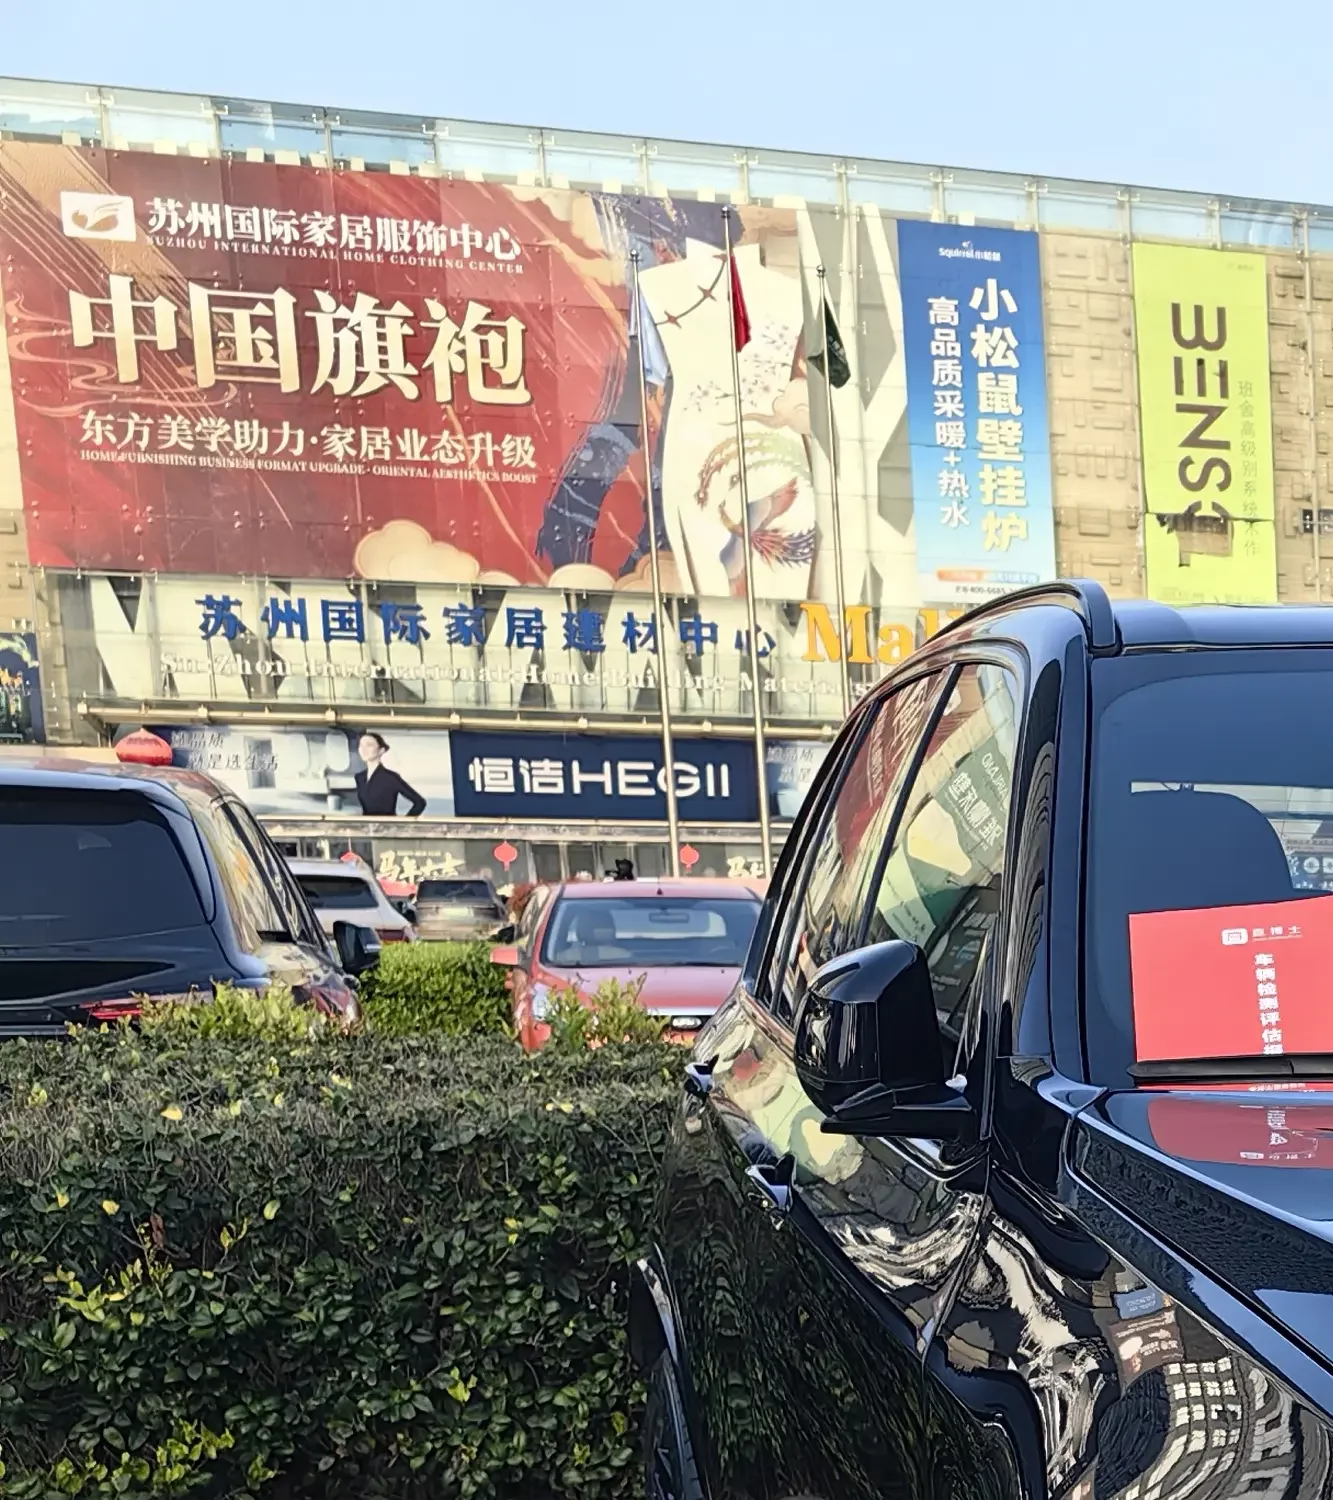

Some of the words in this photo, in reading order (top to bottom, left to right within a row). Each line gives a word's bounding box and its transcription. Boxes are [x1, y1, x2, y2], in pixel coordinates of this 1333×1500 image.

[146, 197, 522, 260] 苏州国际家居服饰中心
[214, 241, 338, 261] INTERNATIONAL
[343, 250, 384, 264] HOME
[390, 255, 463, 271] CLOTHING
[469, 261, 524, 275] CENTER
[69, 273, 532, 406] 中国旗袍
[927, 296, 970, 529] 高品质采暖+热水
[969, 278, 1029, 553] 小松鼠壁挂炉
[256, 459, 307, 473] FORMAT
[198, 594, 777, 660] 苏州国际家居建材中心
[469, 756, 564, 795] 恒洁
[572, 760, 730, 798] HEGII
